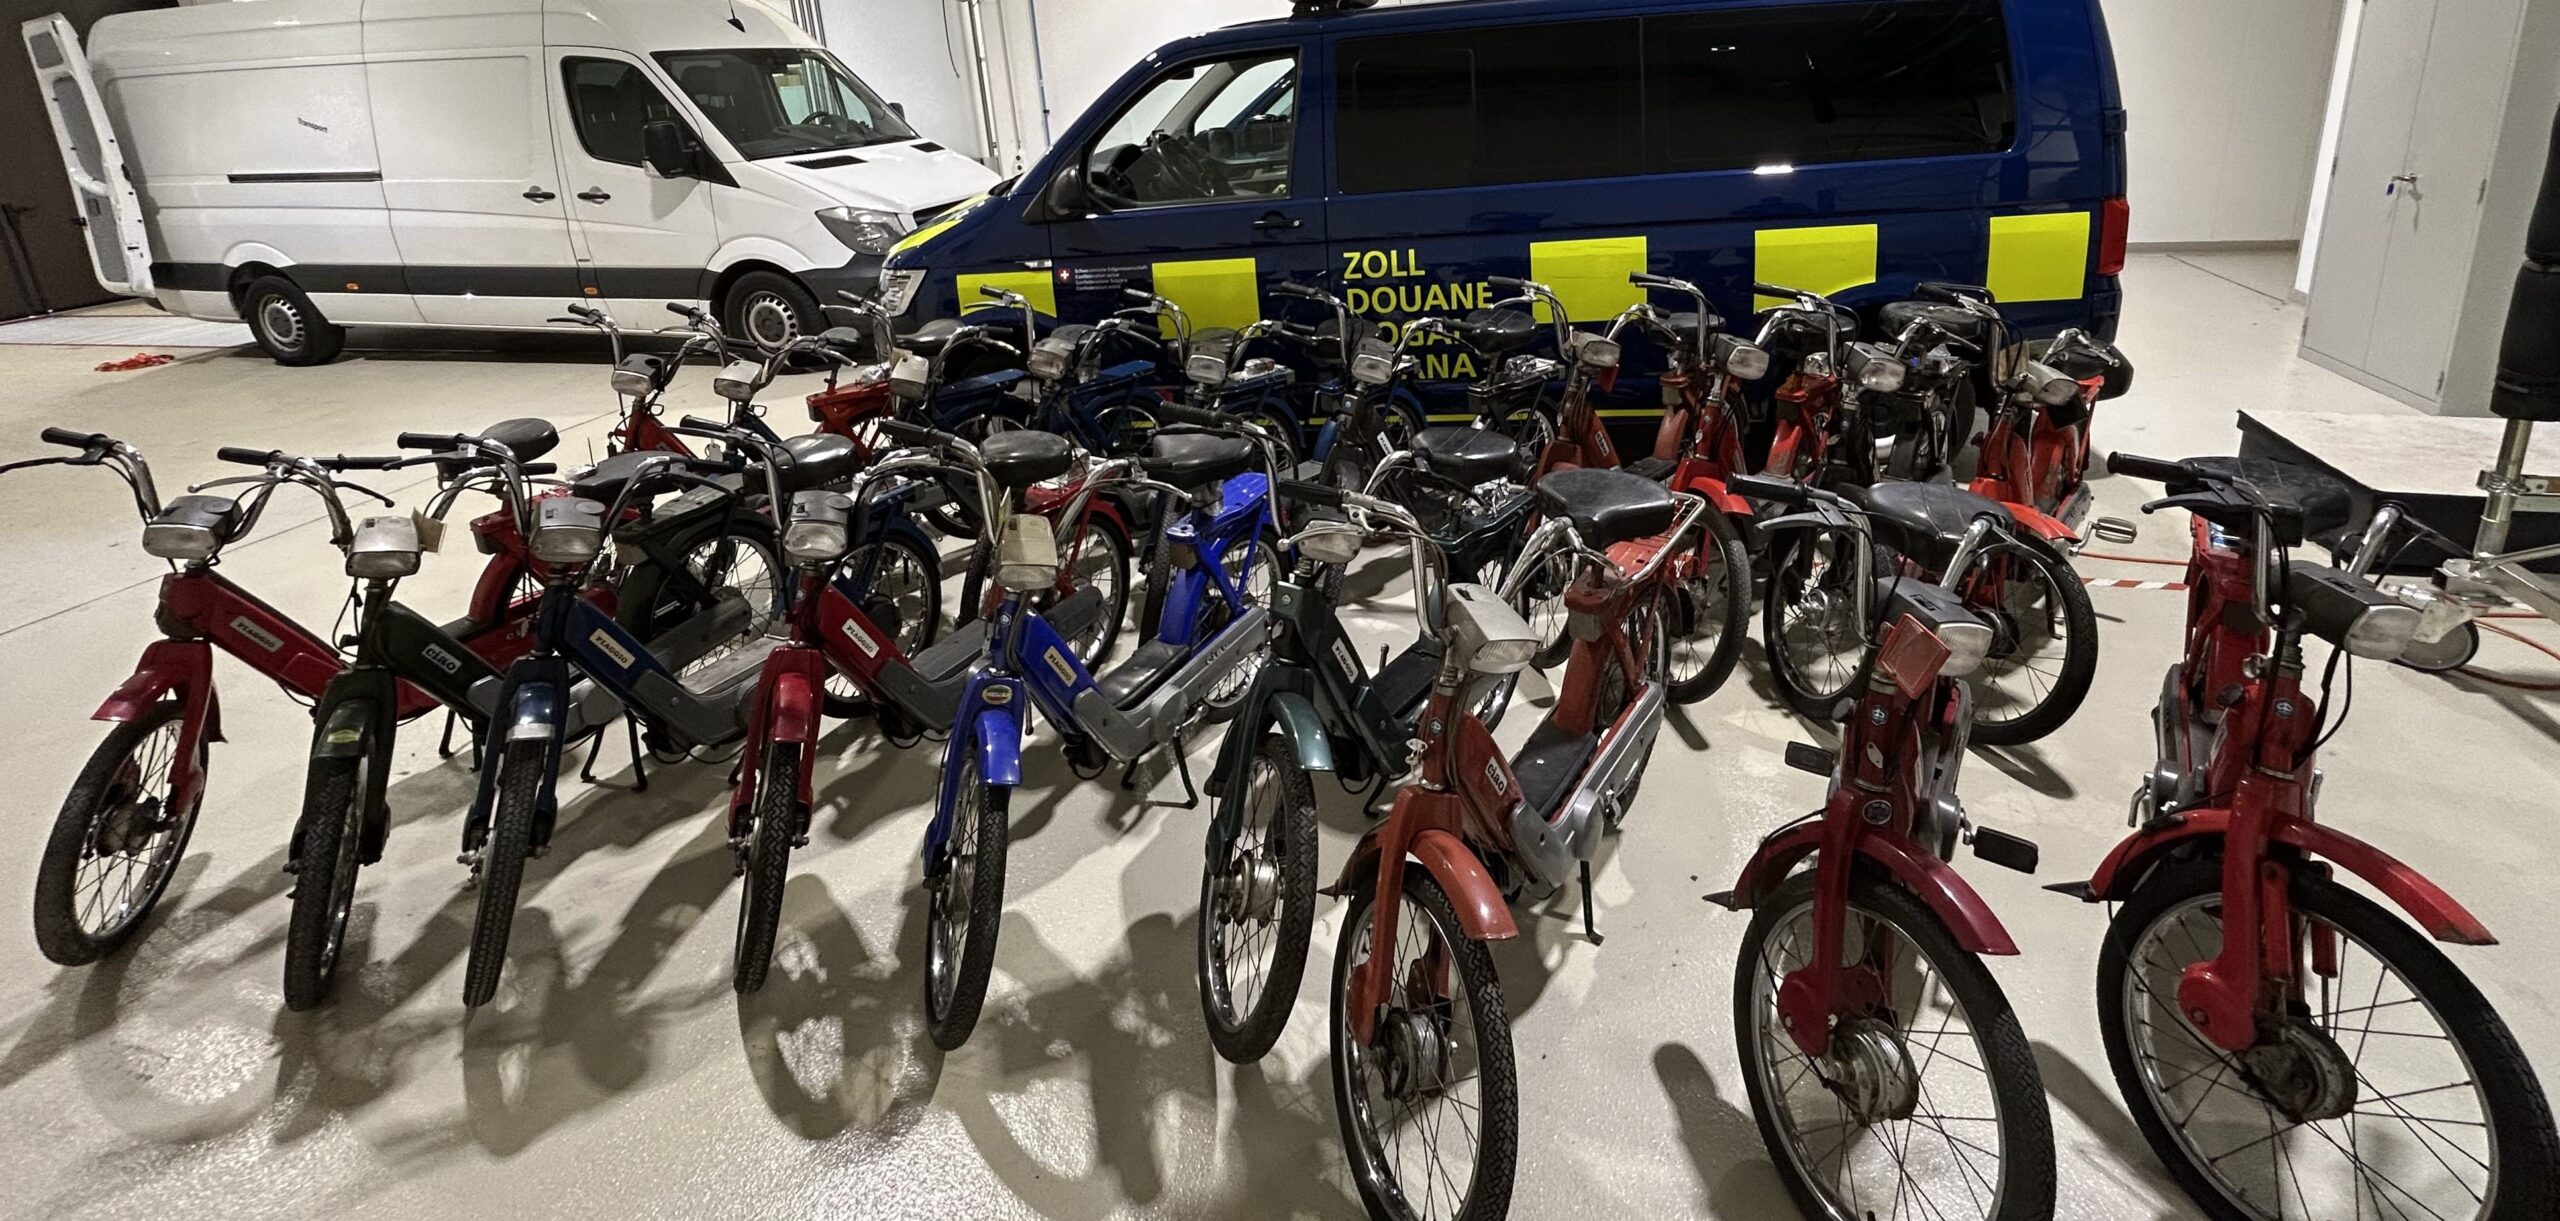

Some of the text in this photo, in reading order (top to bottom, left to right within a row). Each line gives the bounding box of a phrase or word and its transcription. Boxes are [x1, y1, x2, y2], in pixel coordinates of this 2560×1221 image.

[1343, 249, 1426, 280] ZOLL
[1347, 282, 1494, 314] DOUANE
[237, 622, 276, 648] PIAGGIO
[595, 635, 629, 664] PIAGGIO
[846, 625, 874, 653] PIAGGIO
[1048, 654, 1072, 681] PIAGGIO
[1335, 645, 1354, 677] PIAGGIO
[1487, 763, 1505, 792] ciao
